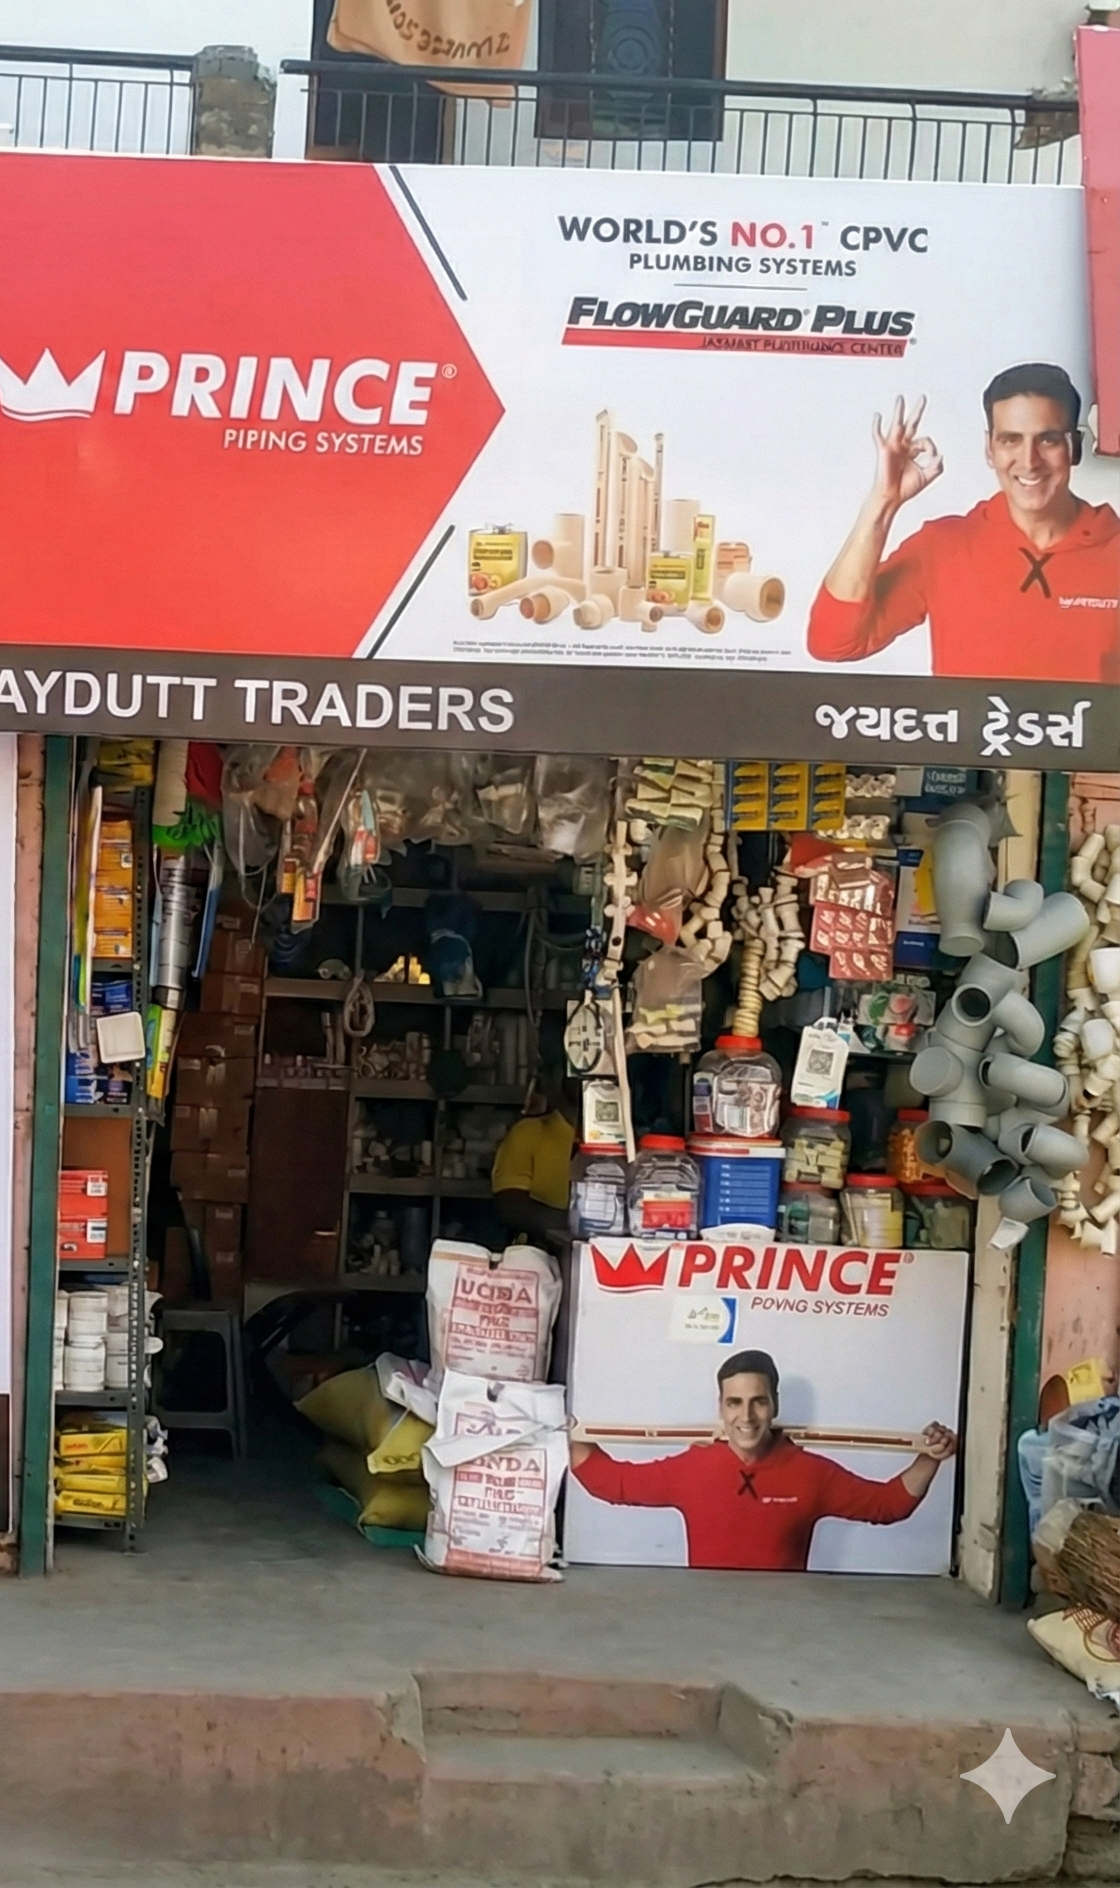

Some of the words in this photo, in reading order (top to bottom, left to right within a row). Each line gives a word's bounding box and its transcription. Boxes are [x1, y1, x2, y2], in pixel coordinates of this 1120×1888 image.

[558, 215, 718, 247] WORLD'S
[839, 226, 929, 253] CPVC
[629, 253, 752, 274] PLUMBING
[759, 258, 857, 277] SYSTEMS
[114, 350, 438, 425] PRINCE
[223, 428, 307, 452] PIPING
[316, 431, 423, 455] SYSTEMS
[234, 678, 514, 733] TRADERS
[678, 1244, 902, 1295] PRINCE
[812, 1300, 890, 1317] SYSTEMS
